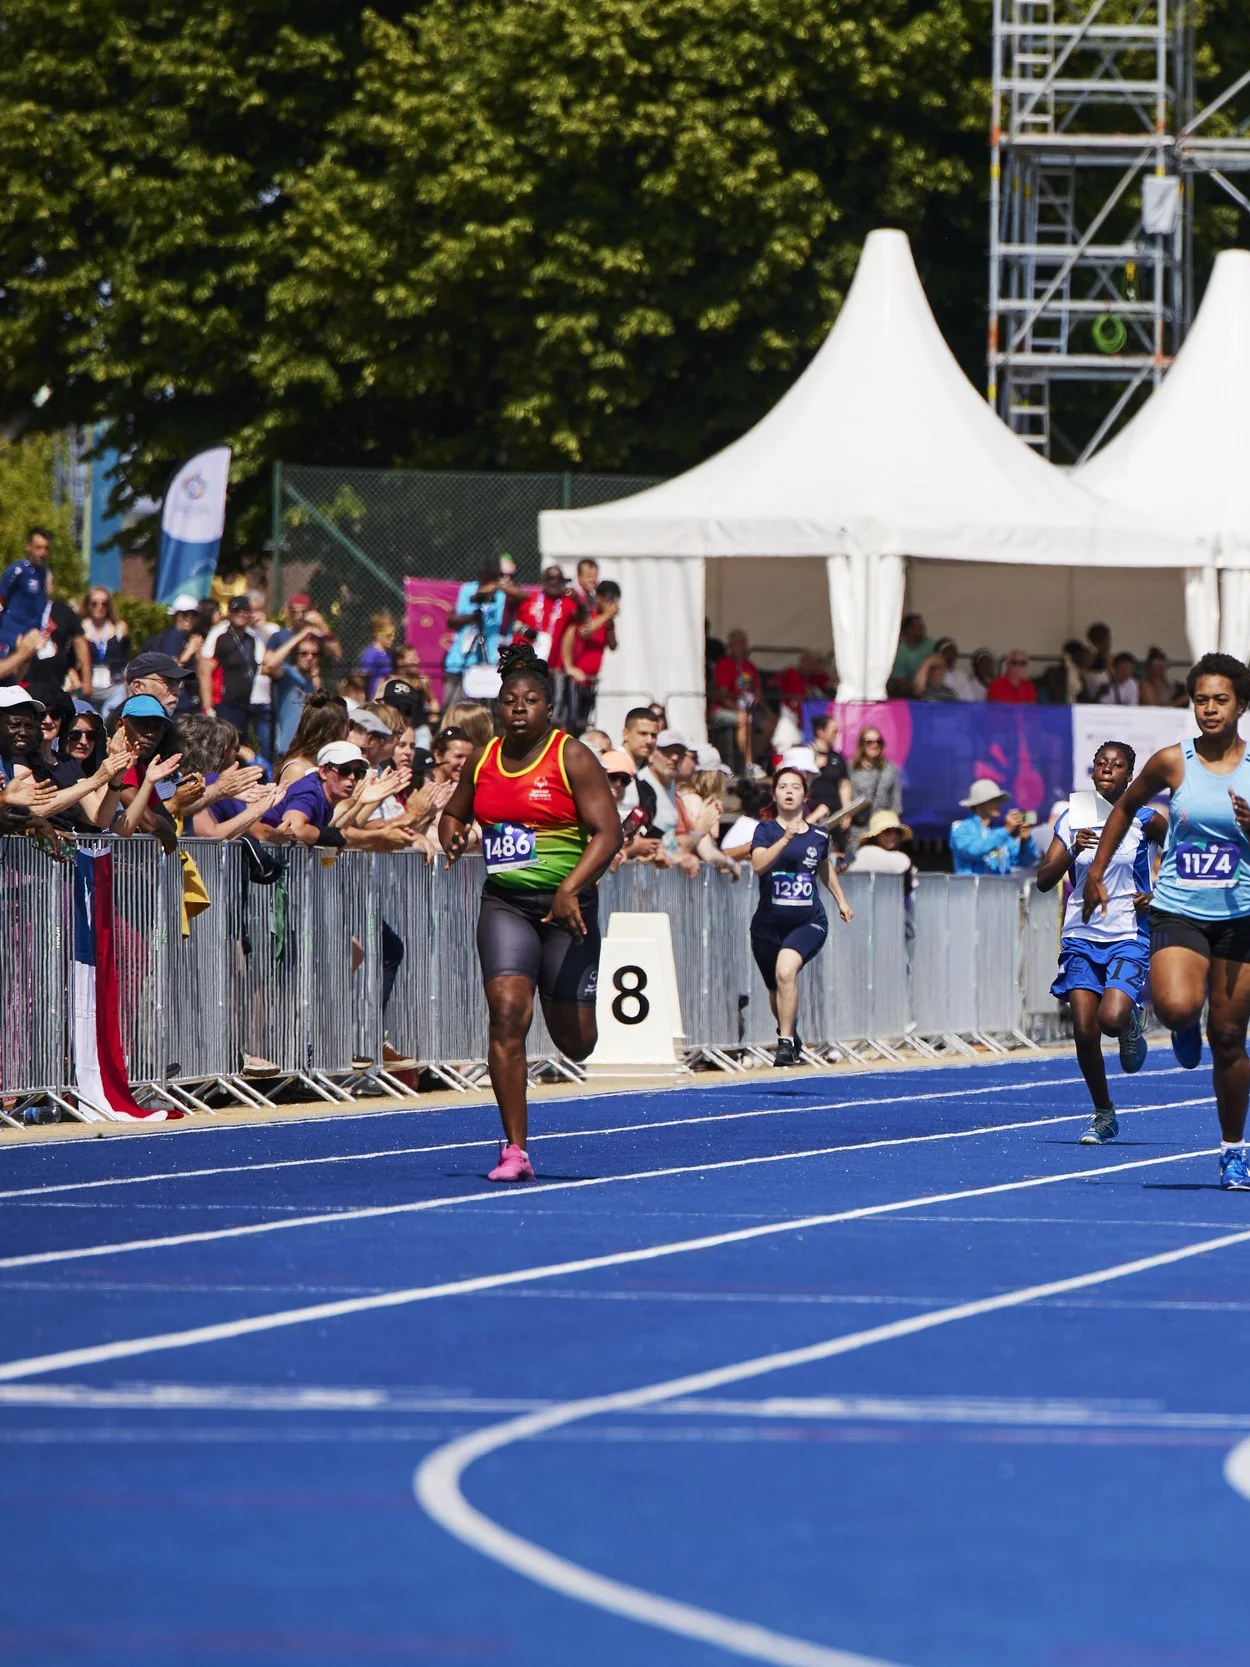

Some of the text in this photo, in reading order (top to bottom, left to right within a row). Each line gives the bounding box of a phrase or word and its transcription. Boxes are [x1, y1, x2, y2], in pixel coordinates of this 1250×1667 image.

[485, 833, 531, 860] 1486
[1183, 853, 1232, 874] 1174
[774, 882, 813, 896] 1290
[1109, 958, 1143, 989] 12
[612, 965, 649, 1025] 8
